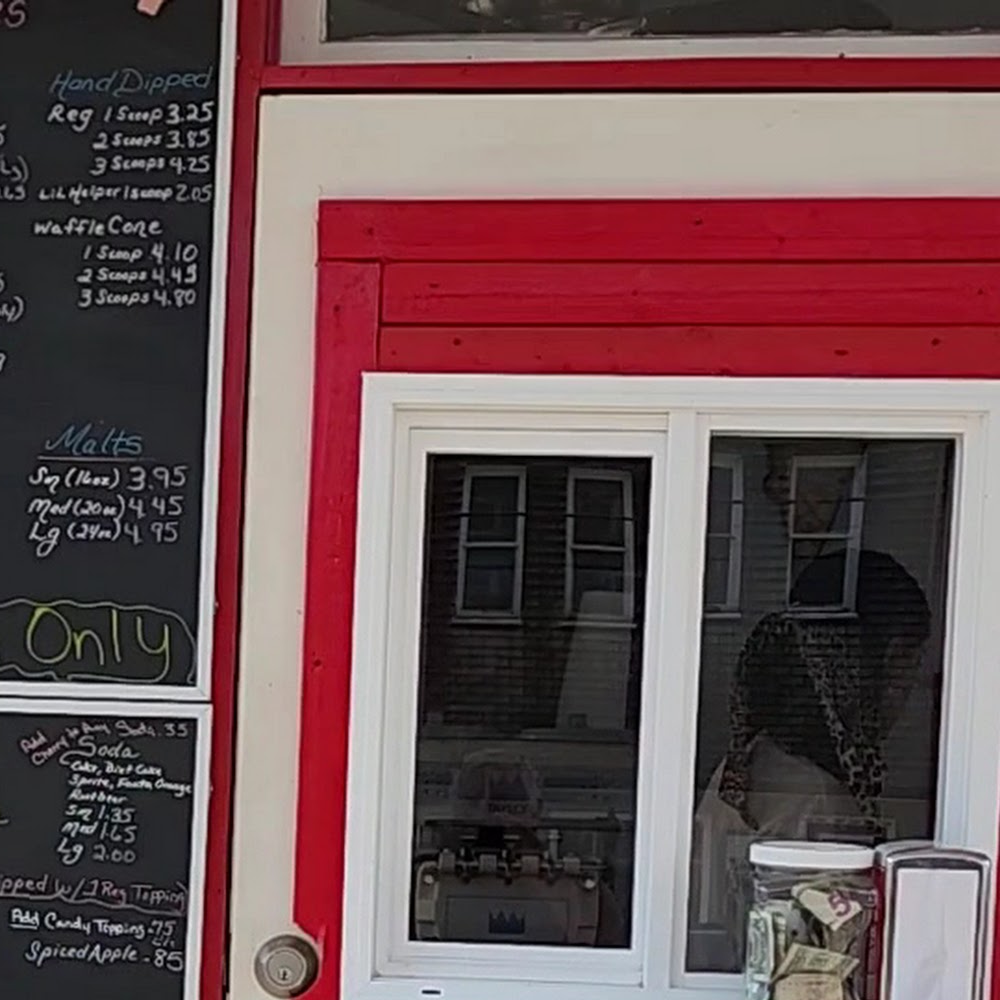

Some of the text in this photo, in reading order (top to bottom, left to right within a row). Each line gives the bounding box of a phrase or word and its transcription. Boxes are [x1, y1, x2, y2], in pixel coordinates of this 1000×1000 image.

[50, 66, 213, 101] Hand Dipped
[47, 104, 95, 132] Reg
[116, 106, 163, 125] Scoop
[166, 102, 215, 124] 3.25
[93, 129, 211, 149] 2 Scoops 3.85
[89, 155, 210, 175] 3 Scoops 4.25
[175, 184, 212, 202] 2.05
[108, 215, 163, 237] Cone
[96, 245, 143, 263] Scoop
[76, 268, 148, 283] 2 Scoops
[78, 289, 150, 308] 3 Scoops
[45, 423, 143, 456] Malts
[127, 465, 189, 491] 3.95
[28, 498, 72, 524] Med
[28, 522, 60, 557] Lg
[27, 606, 170, 682] Only
[59, 735, 140, 765] Soda
[57, 838, 135, 865] Lg 2.00
[827, 890, 852, 916] 5
[25, 941, 138, 966] Spiced Apple
